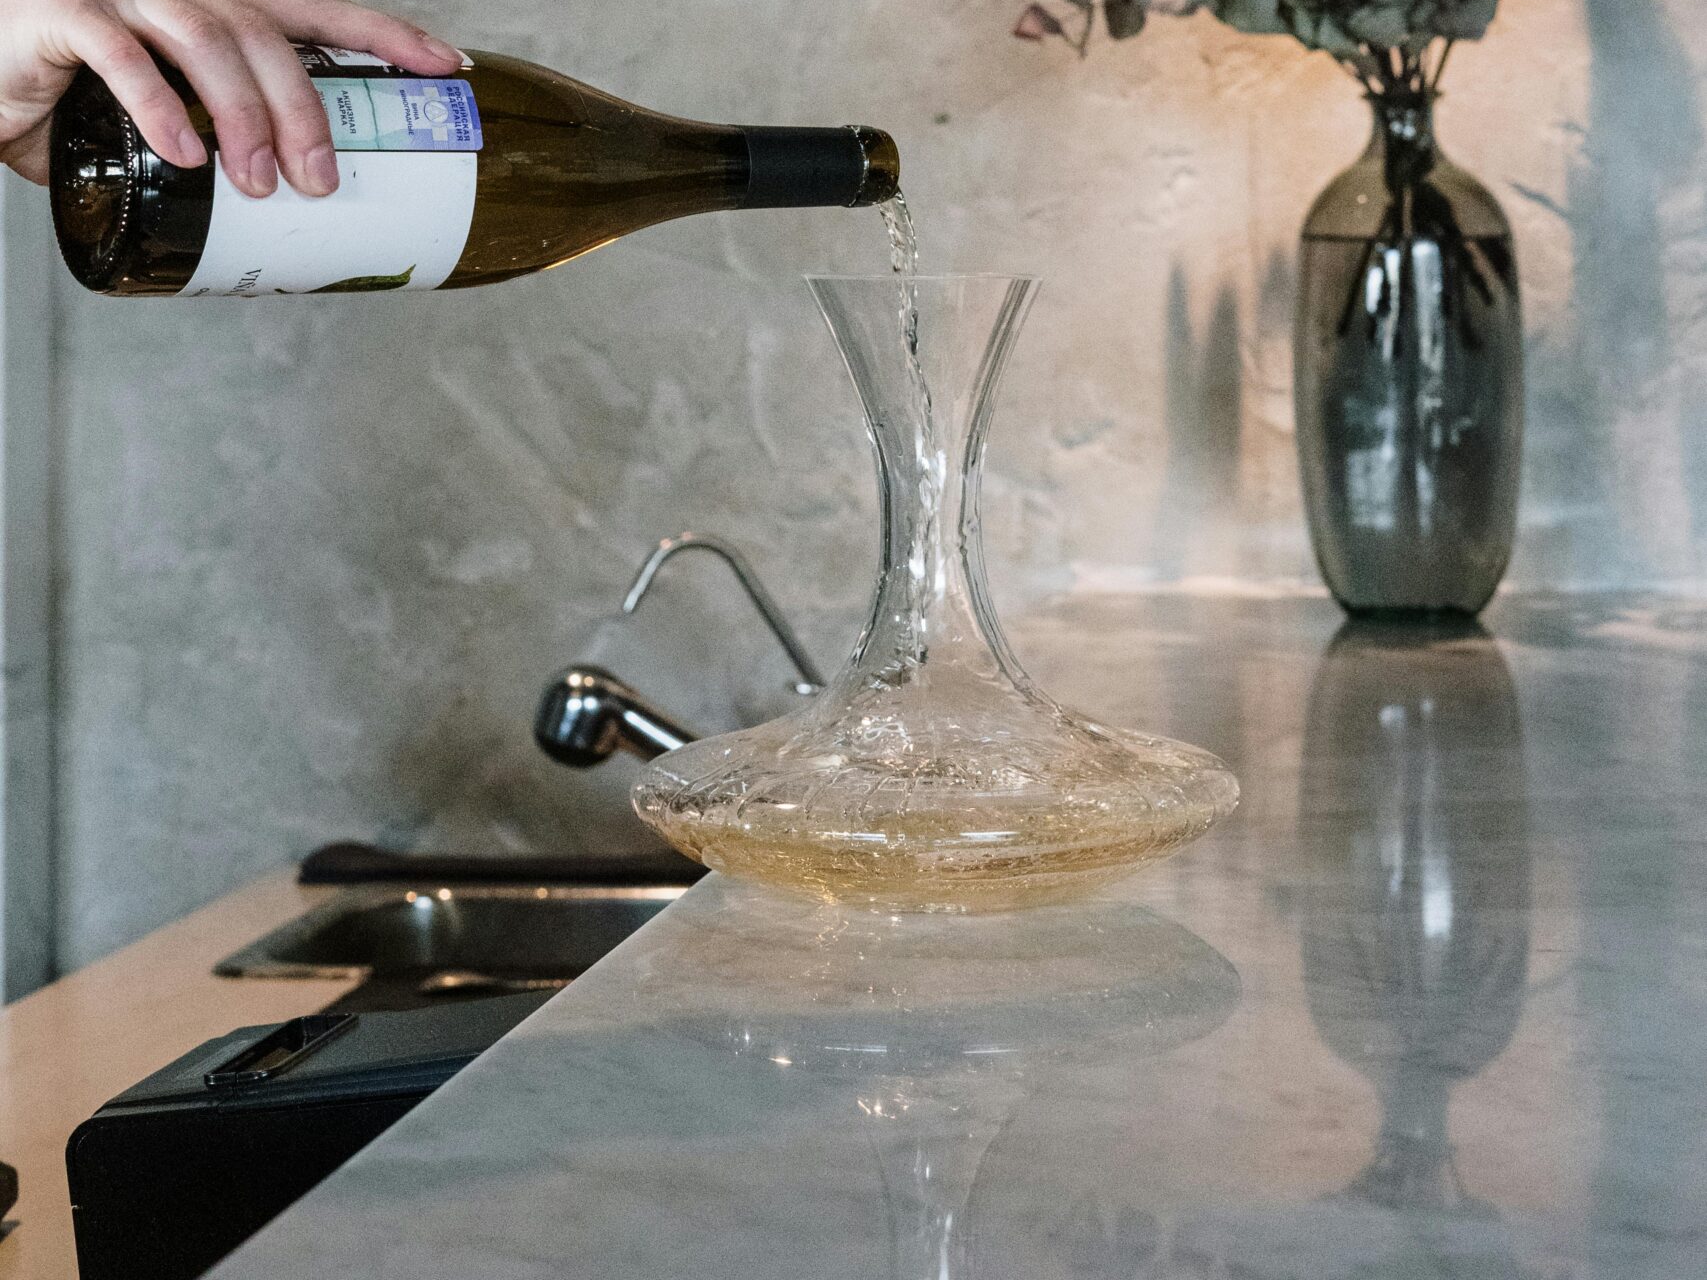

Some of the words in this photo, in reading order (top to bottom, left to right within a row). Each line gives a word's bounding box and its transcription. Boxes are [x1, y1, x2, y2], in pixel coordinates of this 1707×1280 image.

[336, 96, 348, 126] МАРКА
[341, 90, 357, 135] АКЦИЗНАЯ
[399, 89, 415, 136] ВИНОГРАДНЫЕ
[411, 102, 420, 121] ВИНА
[446, 86, 464, 142] ФЕДЕРАЦИЯ
[452, 86, 471, 142] РОССИЙСКАЯ
